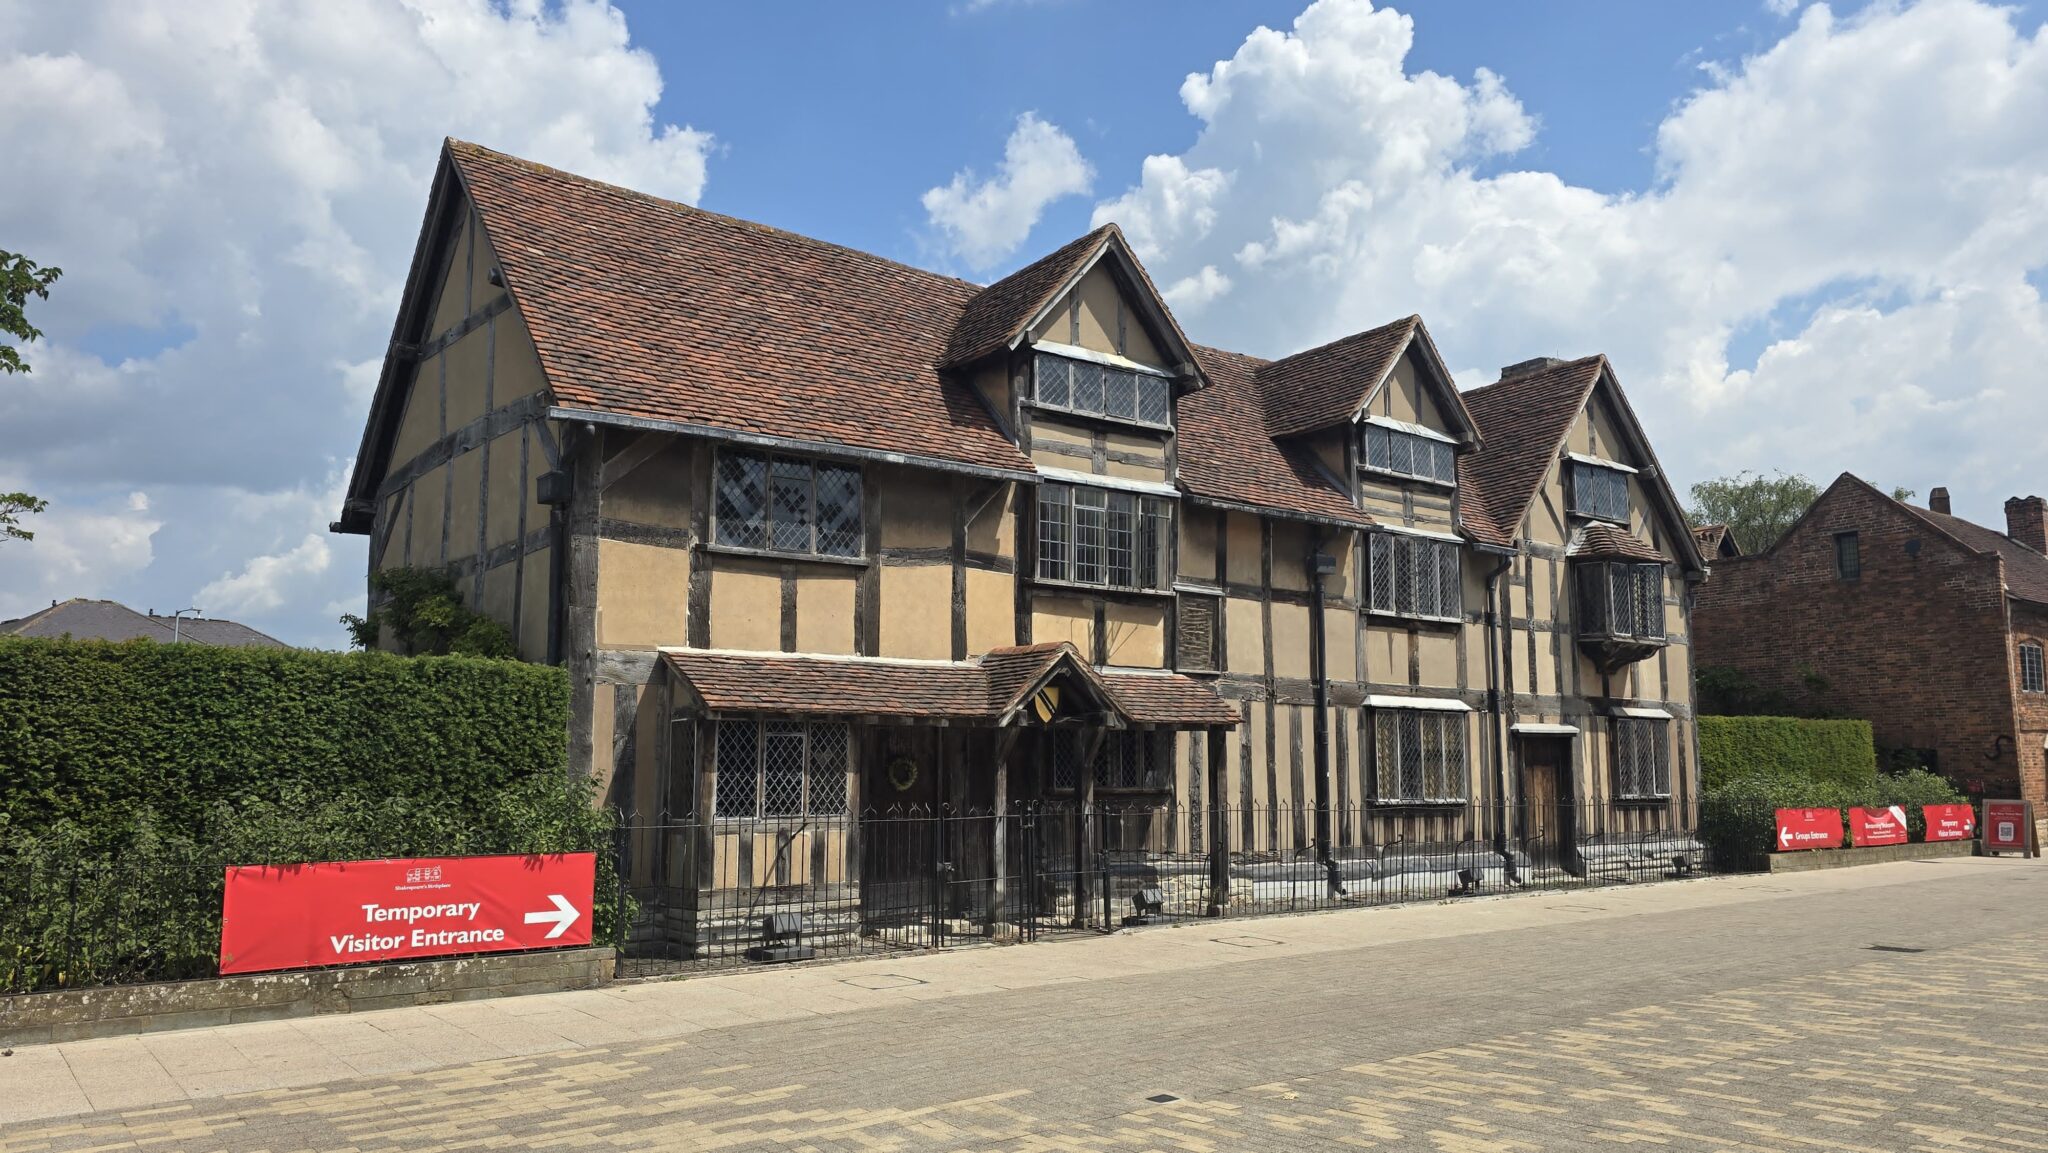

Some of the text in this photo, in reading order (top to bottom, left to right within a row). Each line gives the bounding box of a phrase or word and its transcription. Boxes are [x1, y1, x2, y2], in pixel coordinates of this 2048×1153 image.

[1795, 831, 1828, 842] Groups Entrance
[361, 902, 481, 924] Temporary
[330, 928, 505, 954] Visitor Entrance
